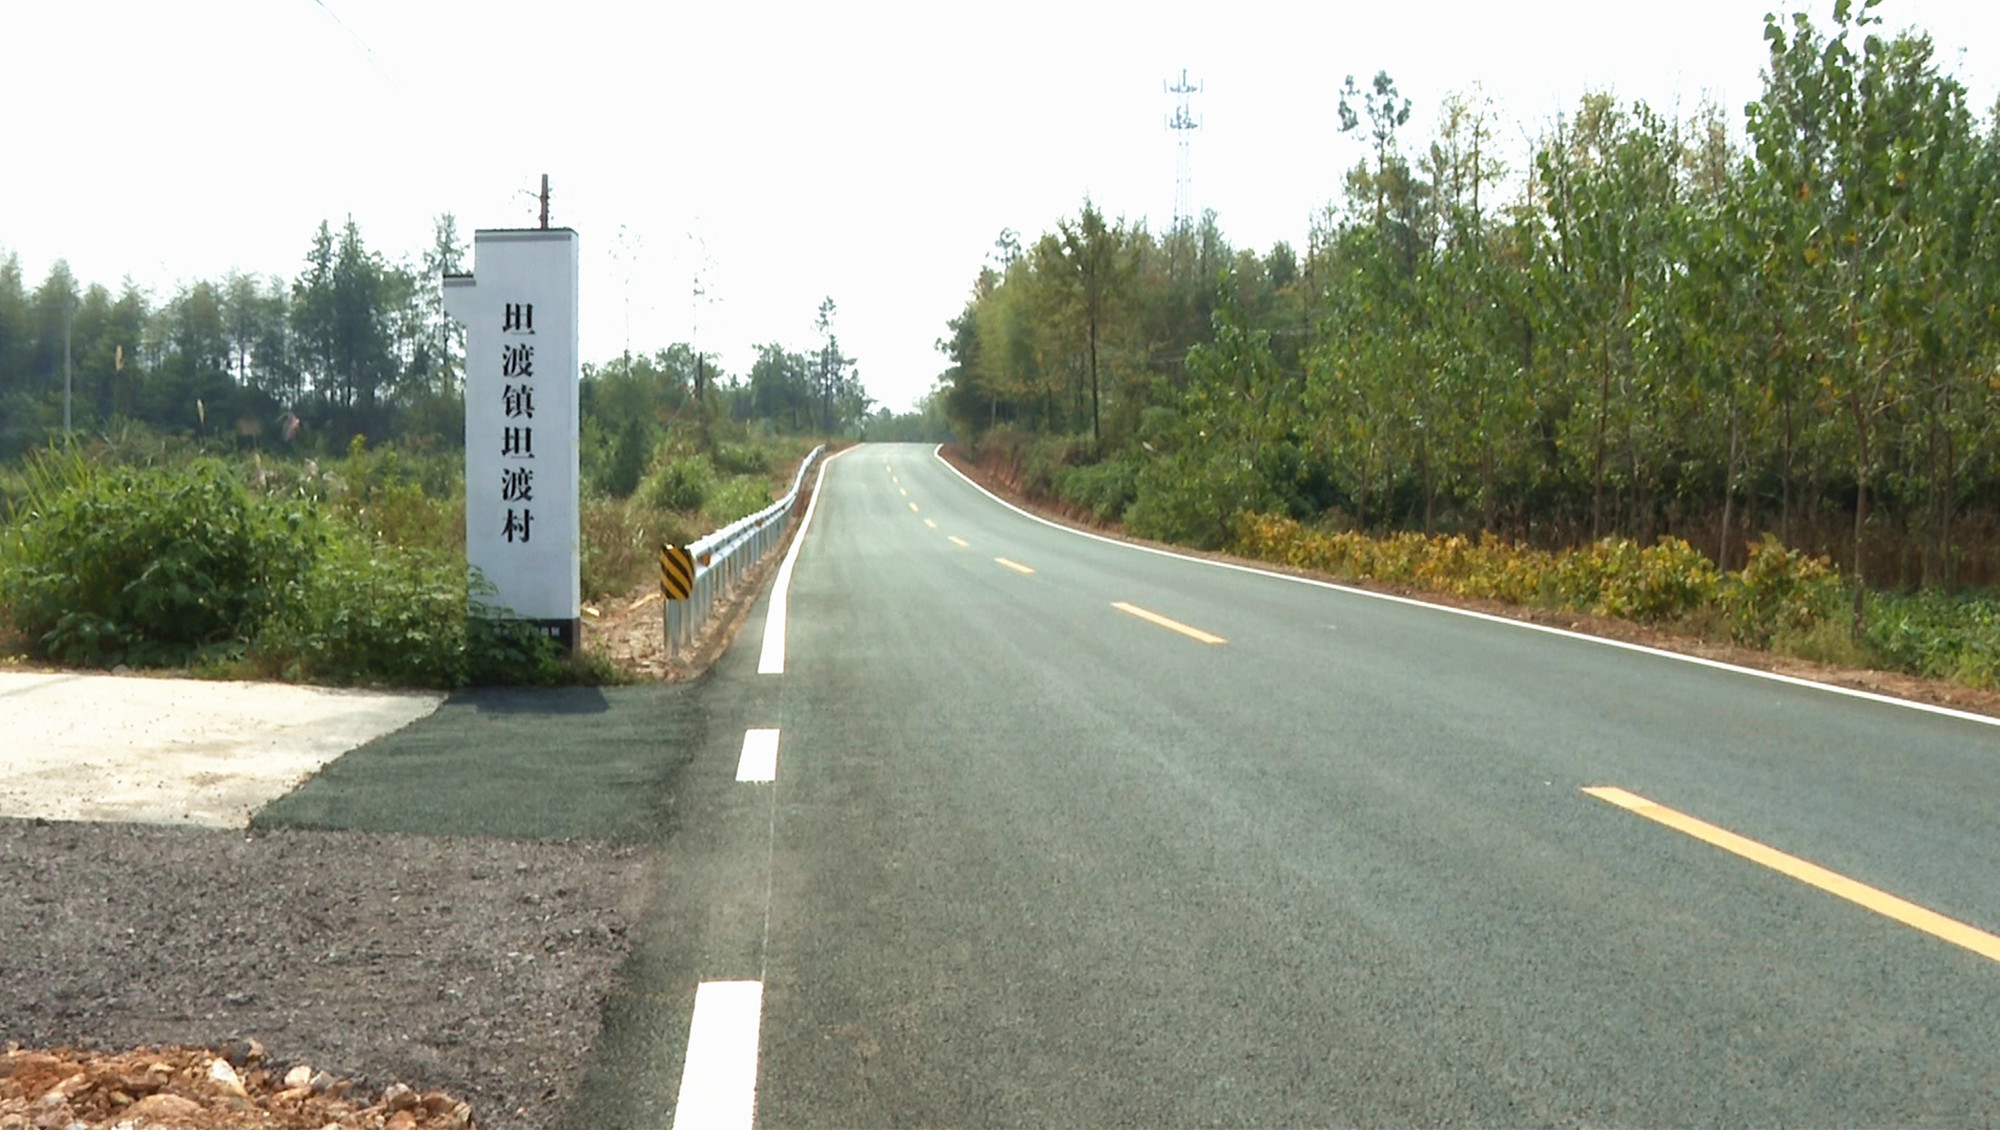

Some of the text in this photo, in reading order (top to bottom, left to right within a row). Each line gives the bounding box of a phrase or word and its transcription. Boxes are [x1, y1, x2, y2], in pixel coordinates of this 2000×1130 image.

[501, 303, 535, 544] 坦渡镇坦渡村
